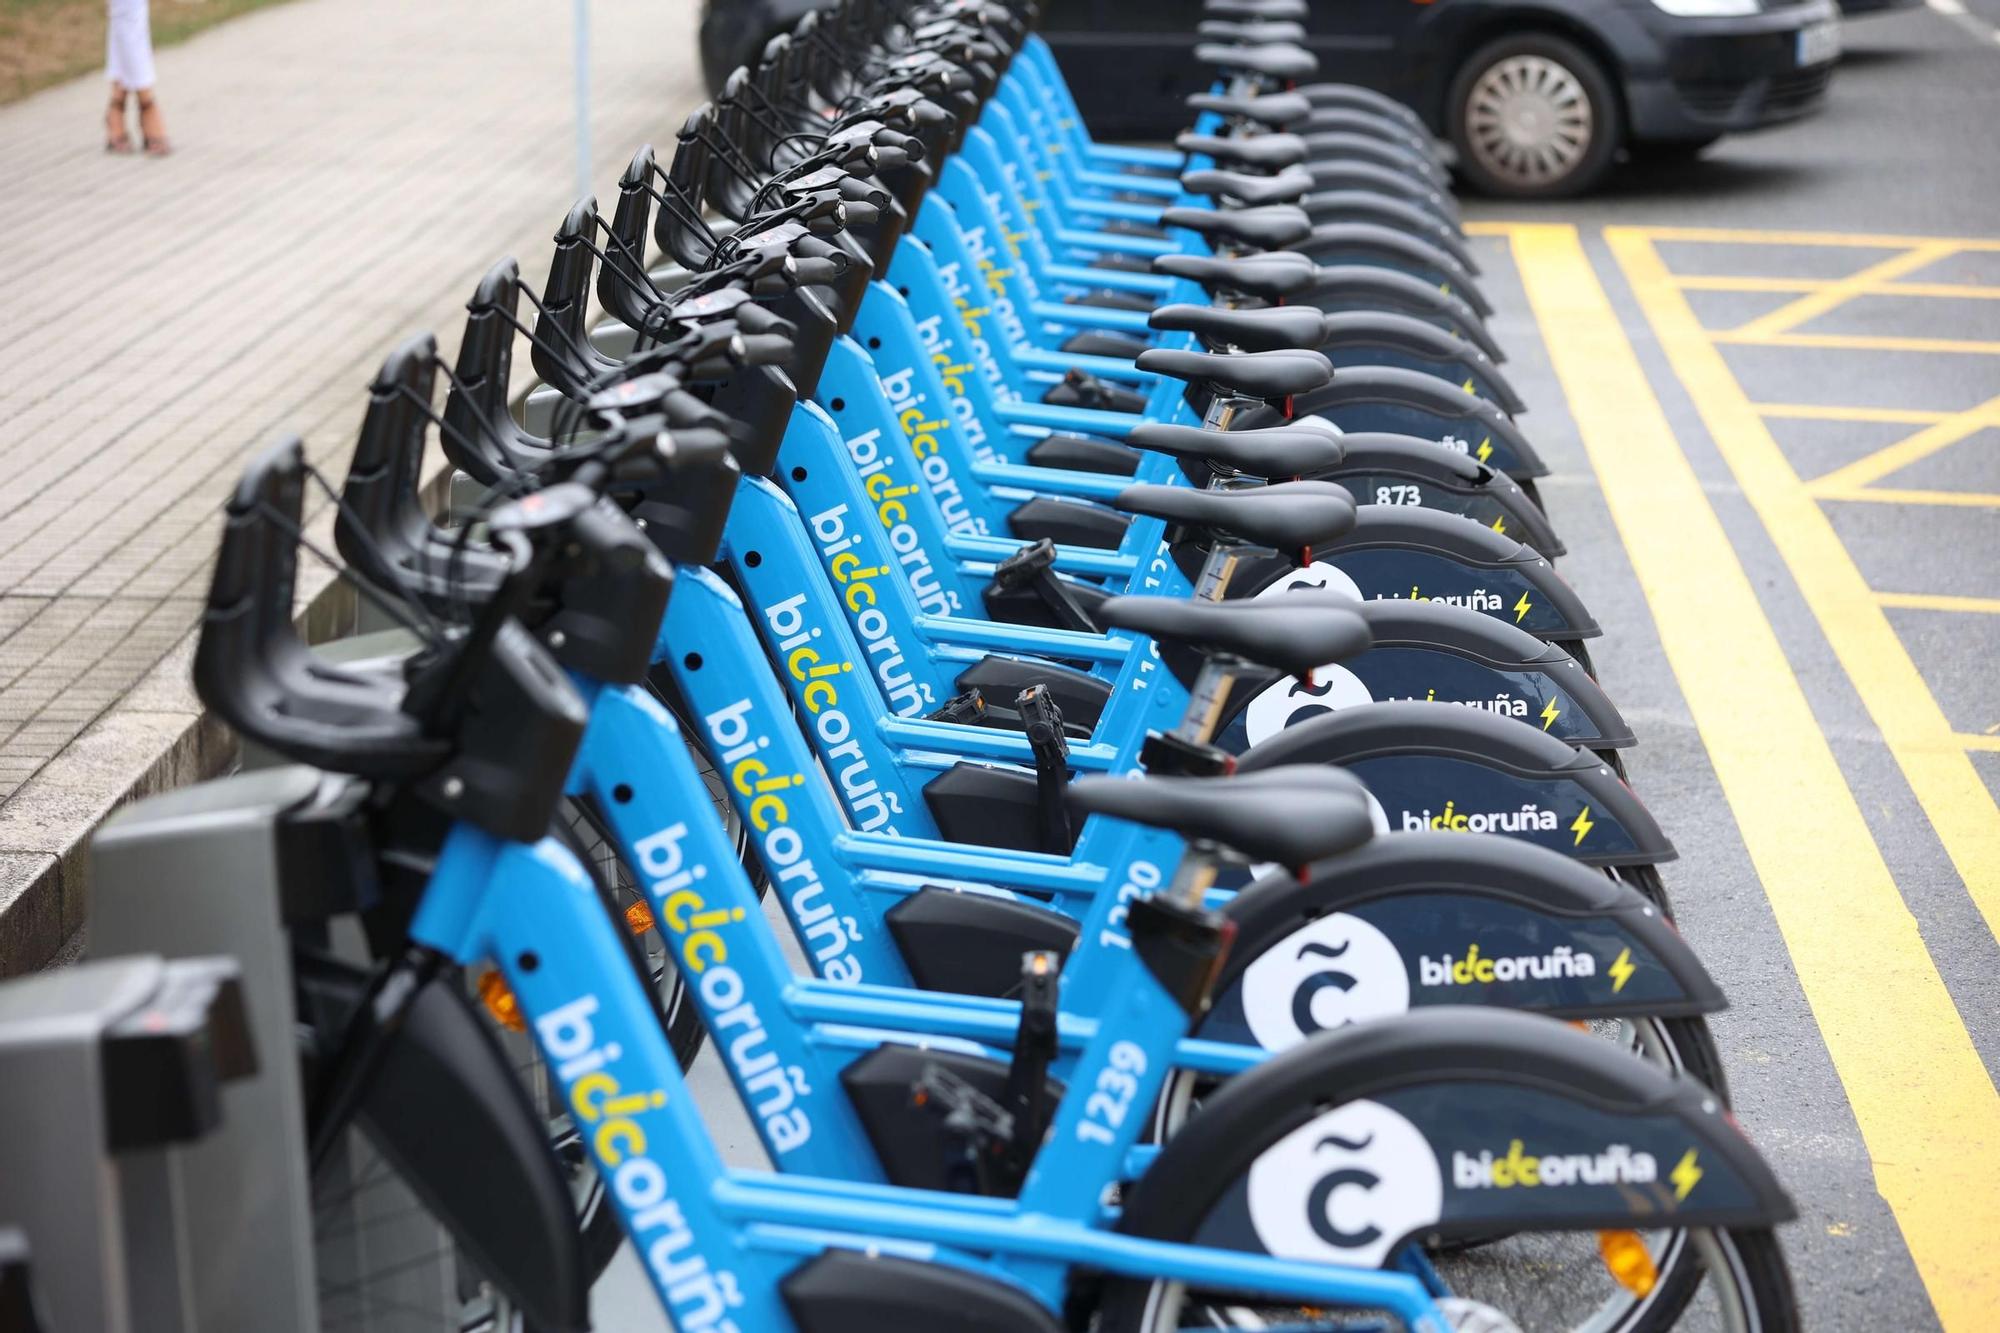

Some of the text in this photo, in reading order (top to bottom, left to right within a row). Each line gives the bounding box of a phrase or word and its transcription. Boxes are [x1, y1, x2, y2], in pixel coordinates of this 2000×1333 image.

[846, 429, 961, 618] bicicoruñ
[881, 367, 989, 536] bicicoruñ
[1376, 485, 1421, 505] 873
[810, 503, 936, 719] bicicoruñ
[765, 593, 903, 840] bicicoruñ
[704, 698, 863, 985] bicicoruña
[1402, 801, 1558, 833] bicicoruña
[633, 821, 812, 1154] bicicoruña
[1420, 944, 1595, 986] bicicoruña
[1075, 1040, 1147, 1145] 1239
[1453, 1140, 1658, 1189] bicicoruña
